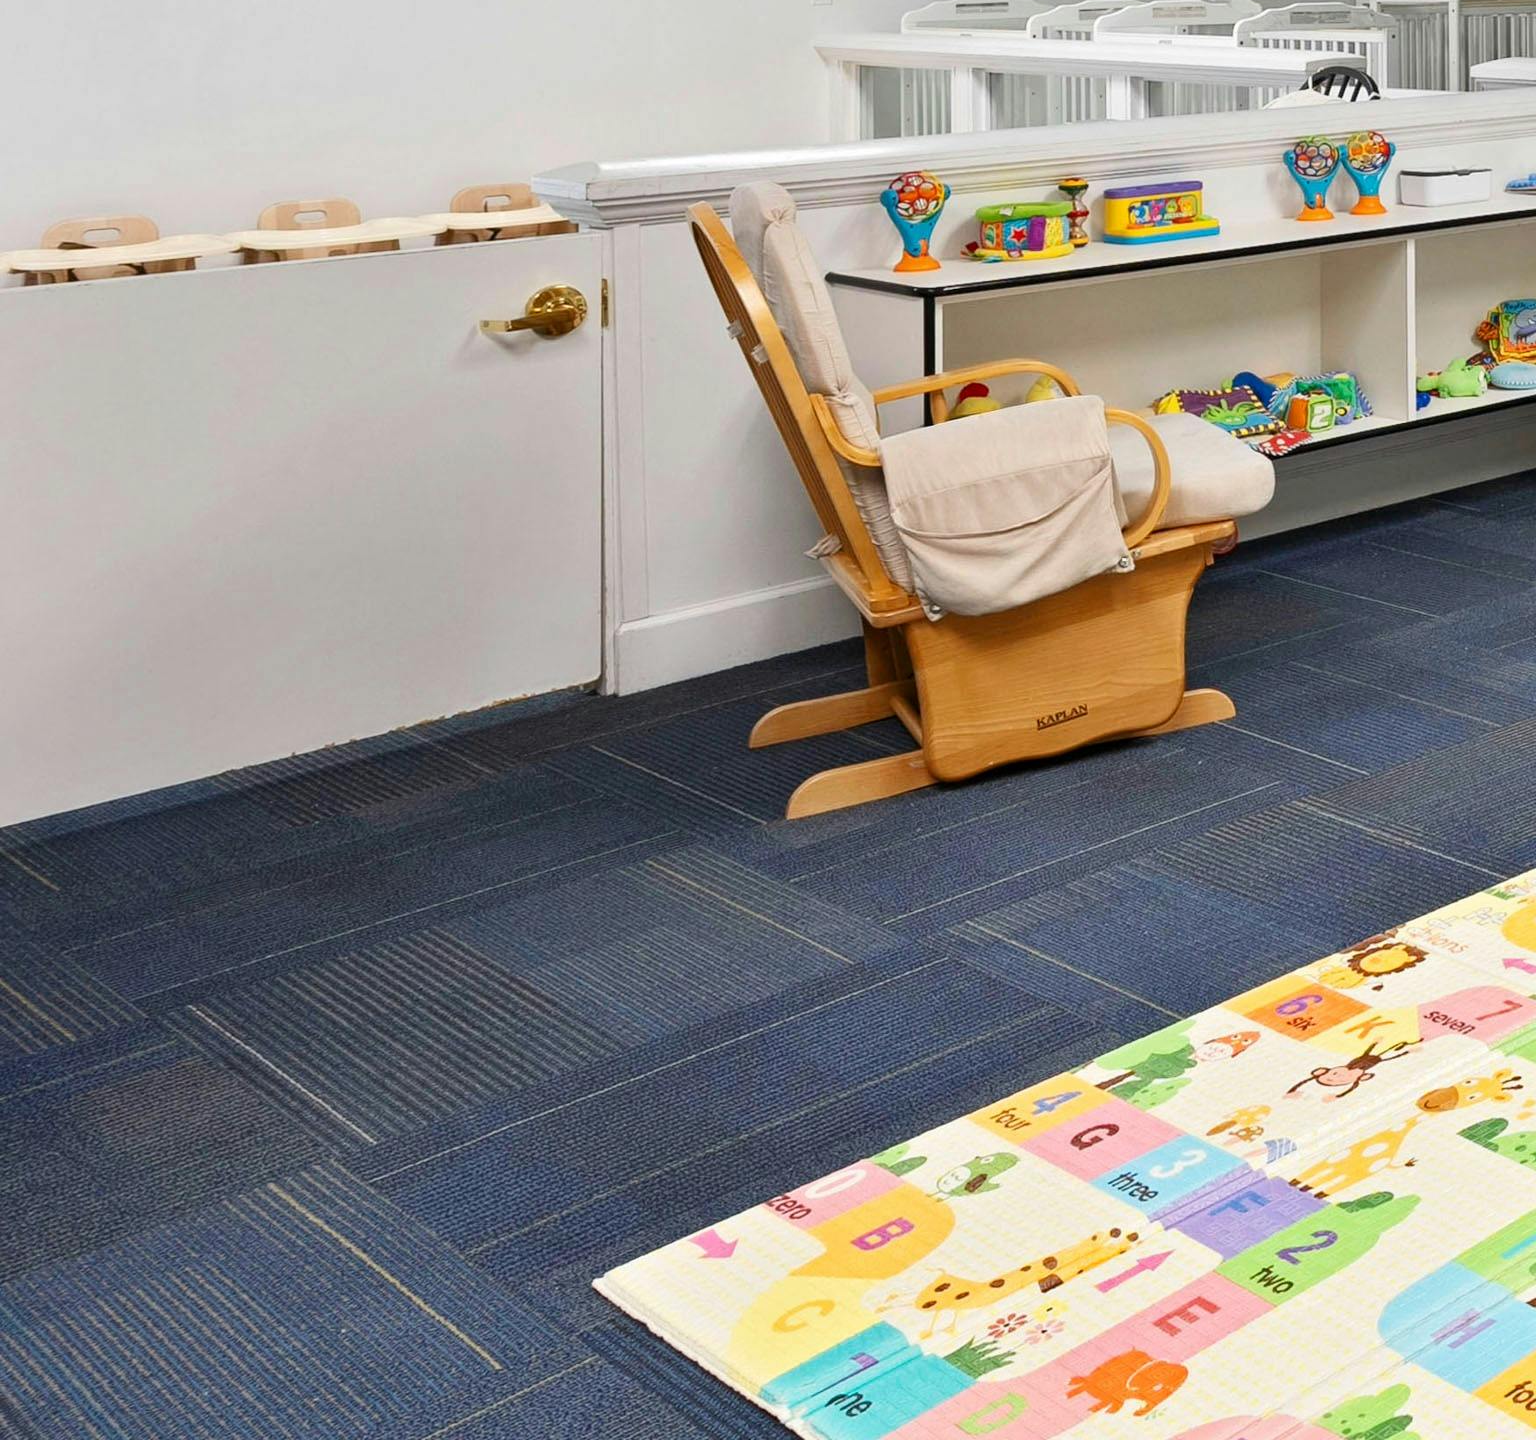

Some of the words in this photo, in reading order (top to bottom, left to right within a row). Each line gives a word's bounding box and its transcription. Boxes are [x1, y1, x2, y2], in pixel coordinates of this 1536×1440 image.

[1310, 404, 1333, 429] 2
[1036, 703, 1088, 730] KAPLAN
[1274, 993, 1324, 1018] 6
[1476, 999, 1524, 1021] 7
[1285, 1015, 1318, 1033] six
[1343, 1015, 1396, 1041] K
[1422, 1009, 1476, 1036] seven
[1029, 1090, 1082, 1118] 4
[990, 1107, 1034, 1133] four
[1070, 1122, 1121, 1152] G
[1149, 1149, 1208, 1181] 3
[1107, 1170, 1159, 1203] three
[765, 1194, 812, 1220] zero
[1209, 1191, 1273, 1219] F
[850, 1216, 916, 1251] B
[1274, 1229, 1339, 1266] 2
[1249, 1264, 1294, 1294] two
[772, 1298, 835, 1334] C
[1153, 1295, 1222, 1337] E
[954, 1392, 1029, 1436] D
